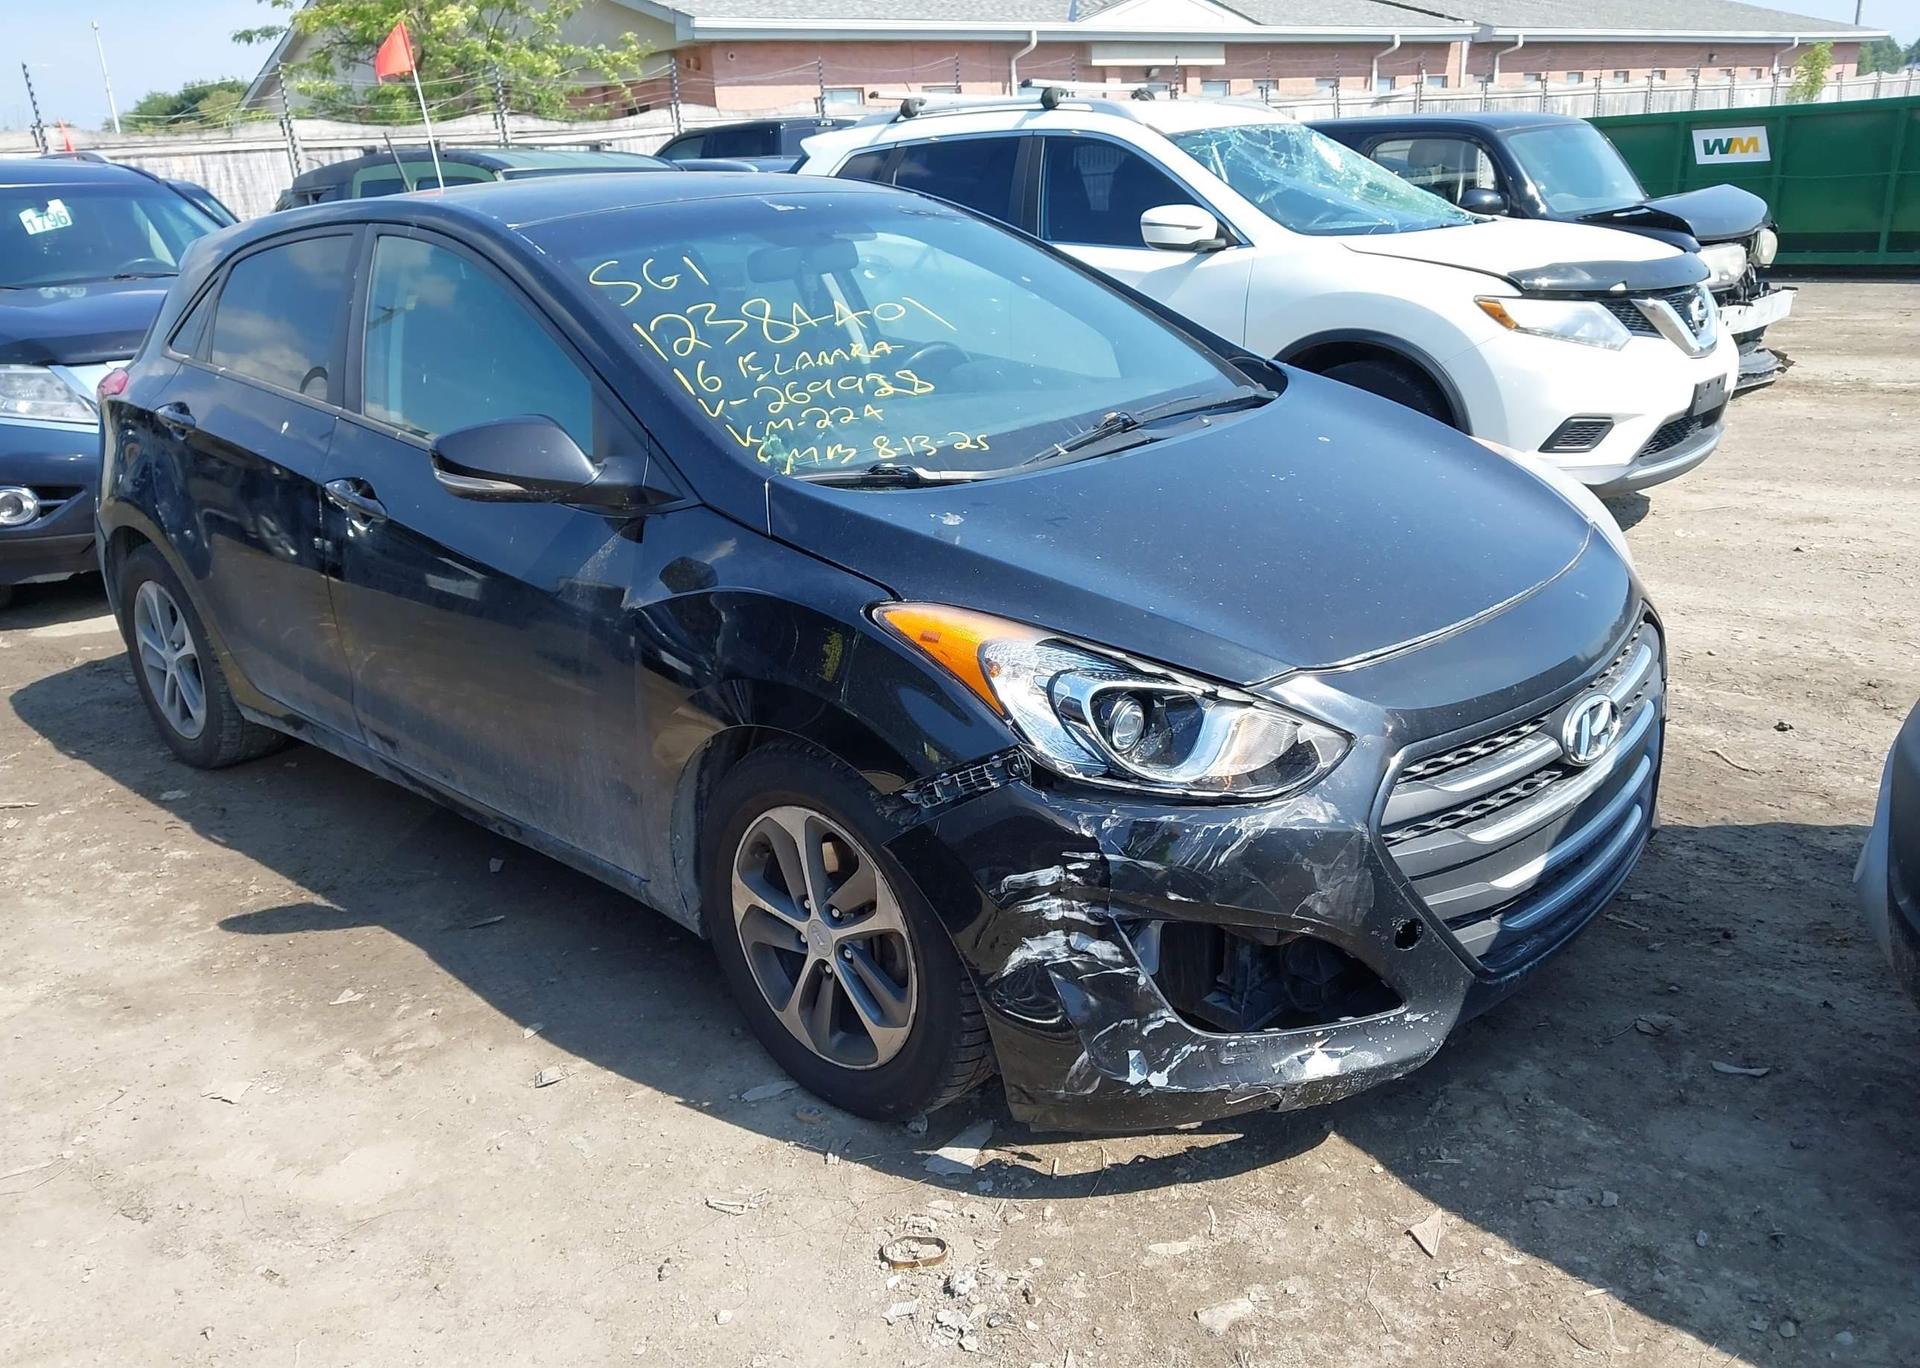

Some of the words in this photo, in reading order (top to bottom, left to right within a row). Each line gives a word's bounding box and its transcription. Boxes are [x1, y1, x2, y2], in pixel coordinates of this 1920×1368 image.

[1703, 136, 1759, 155] WM
[25, 210, 68, 231] 1796
[673, 360, 722, 396] 16
[873, 432, 990, 458] 8-13-25
